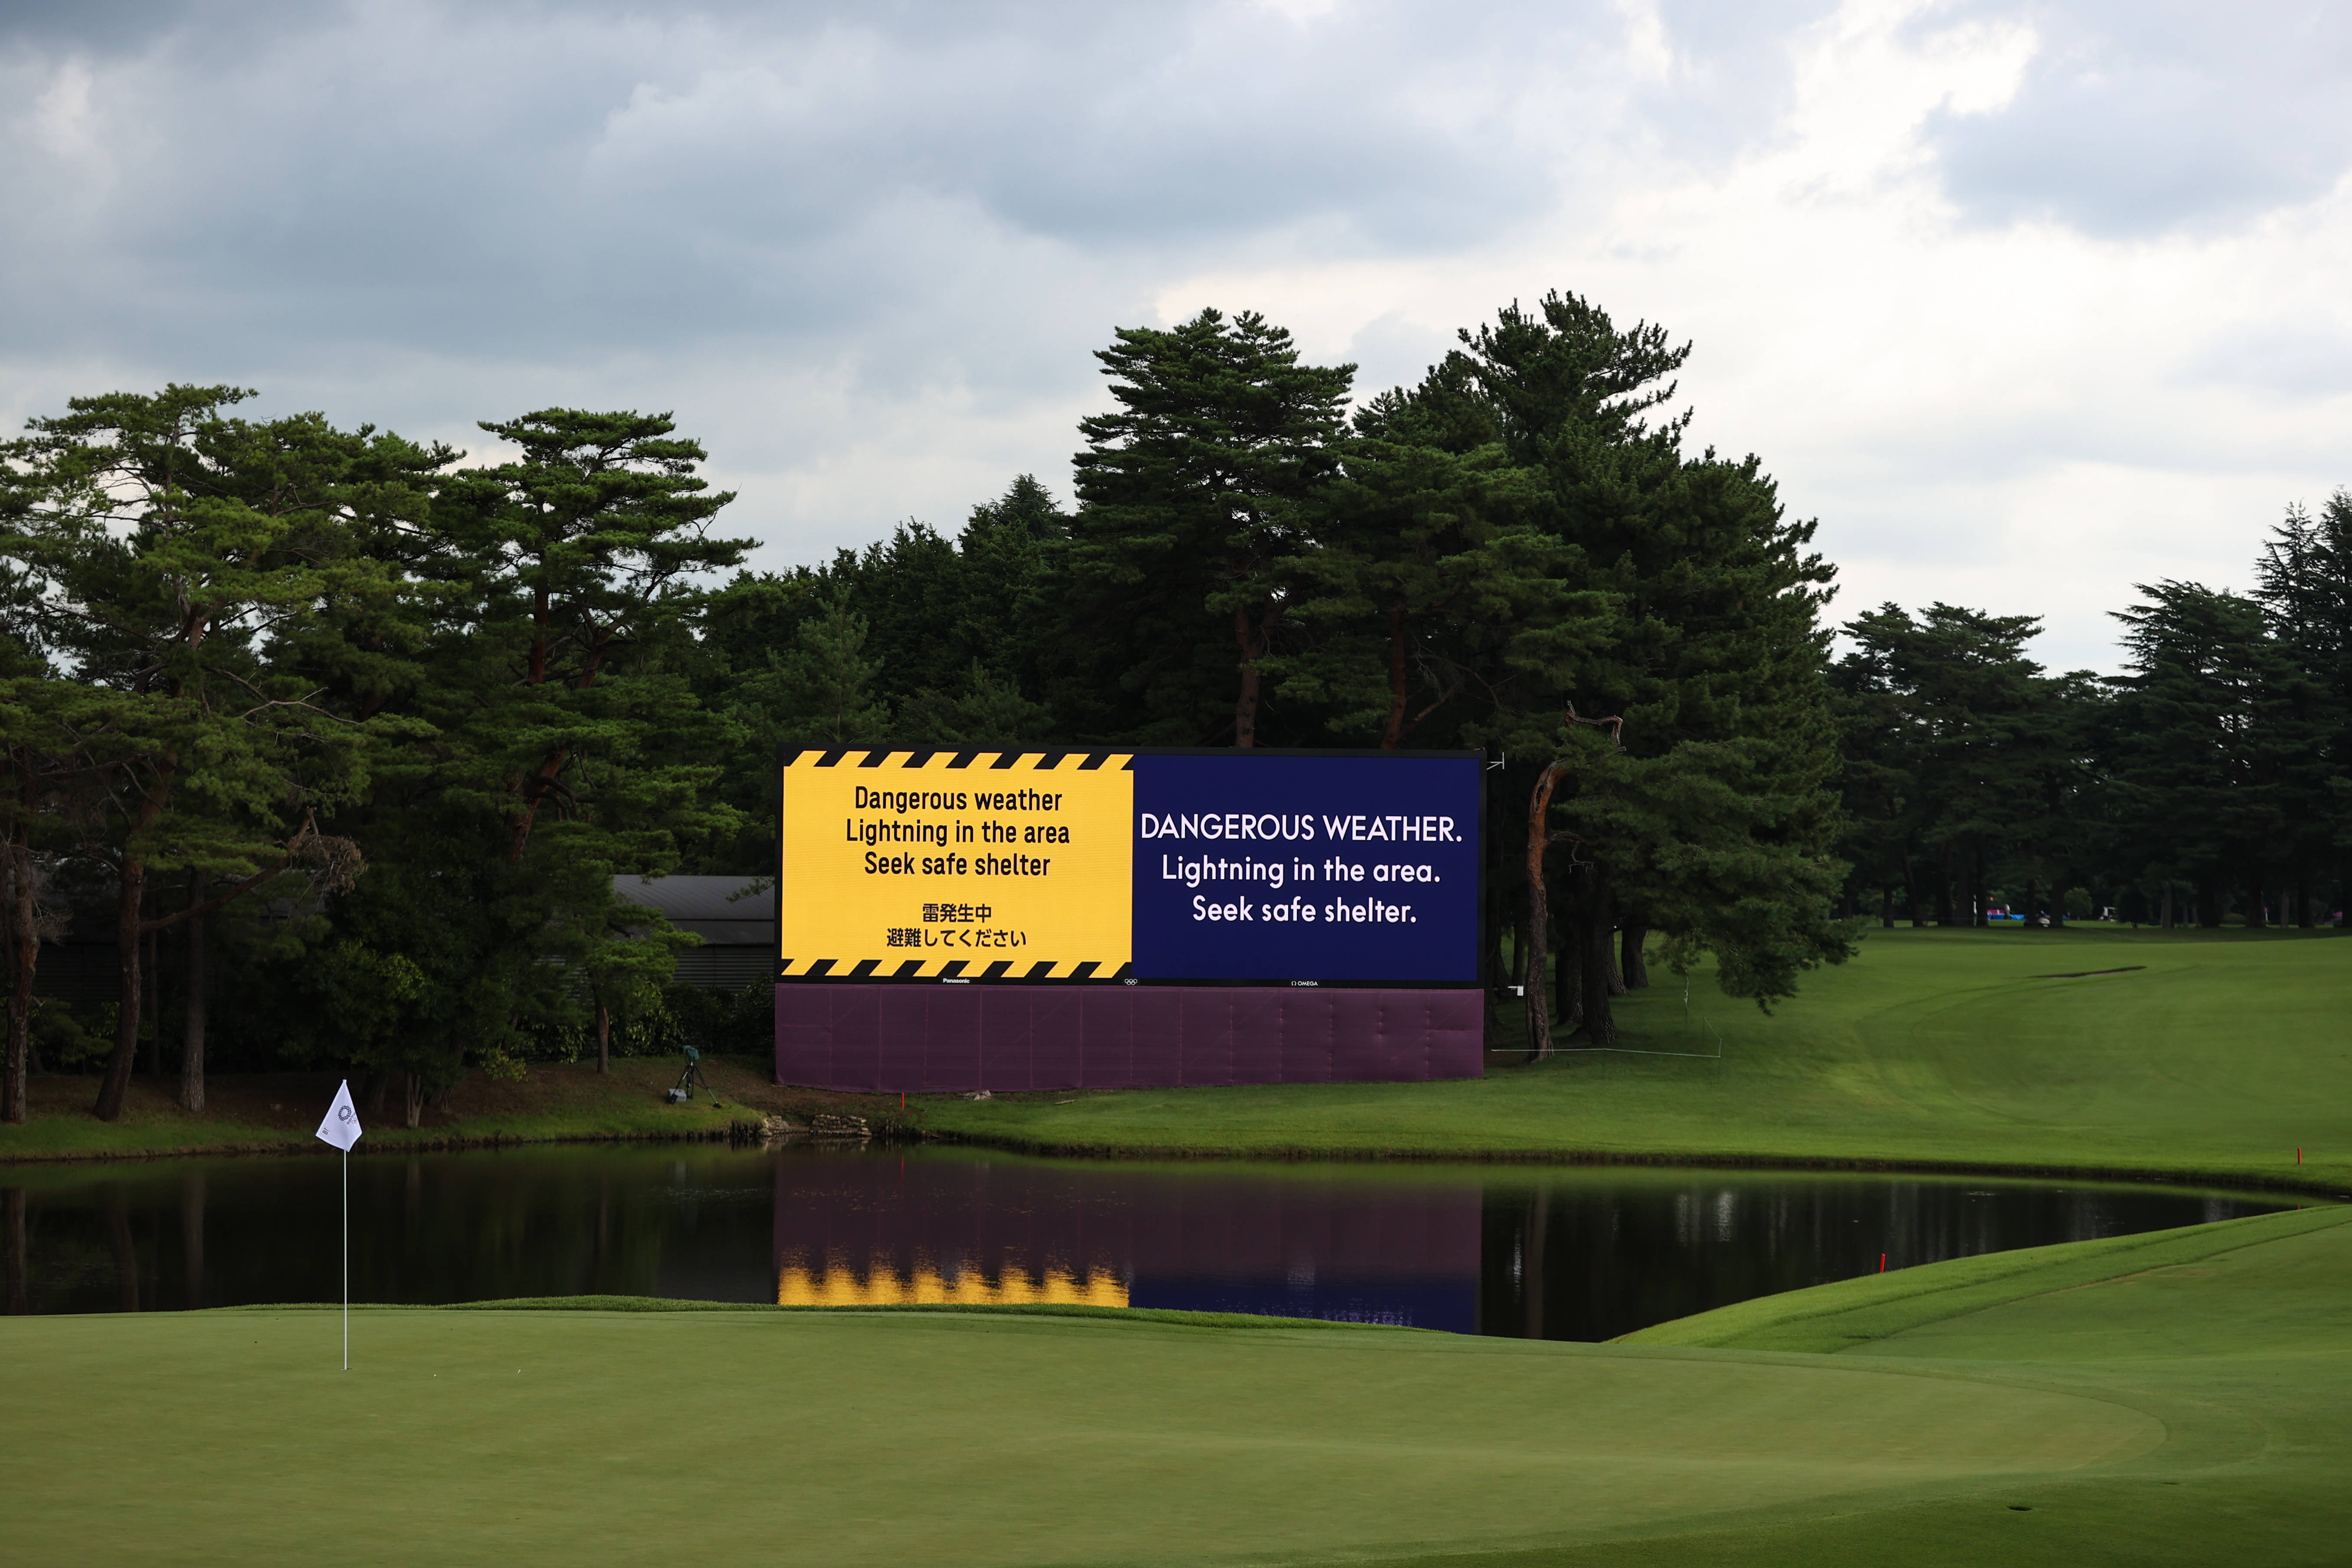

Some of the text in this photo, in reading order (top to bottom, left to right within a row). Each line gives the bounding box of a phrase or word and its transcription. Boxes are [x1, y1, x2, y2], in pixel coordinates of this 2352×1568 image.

[855, 786, 1062, 814] Dangerous weather
[847, 818, 1070, 847] Lightning in the area
[1141, 813, 1462, 842] DANGEROUS WEATHER.
[865, 851, 1051, 876] Seek safe shelter
[1163, 854, 1441, 889] Lightning in the area.
[922, 903, 992, 923] 雷発生中
[1193, 895, 1417, 923] Seek safe shelter.
[887, 928, 1026, 948] 避難してください
